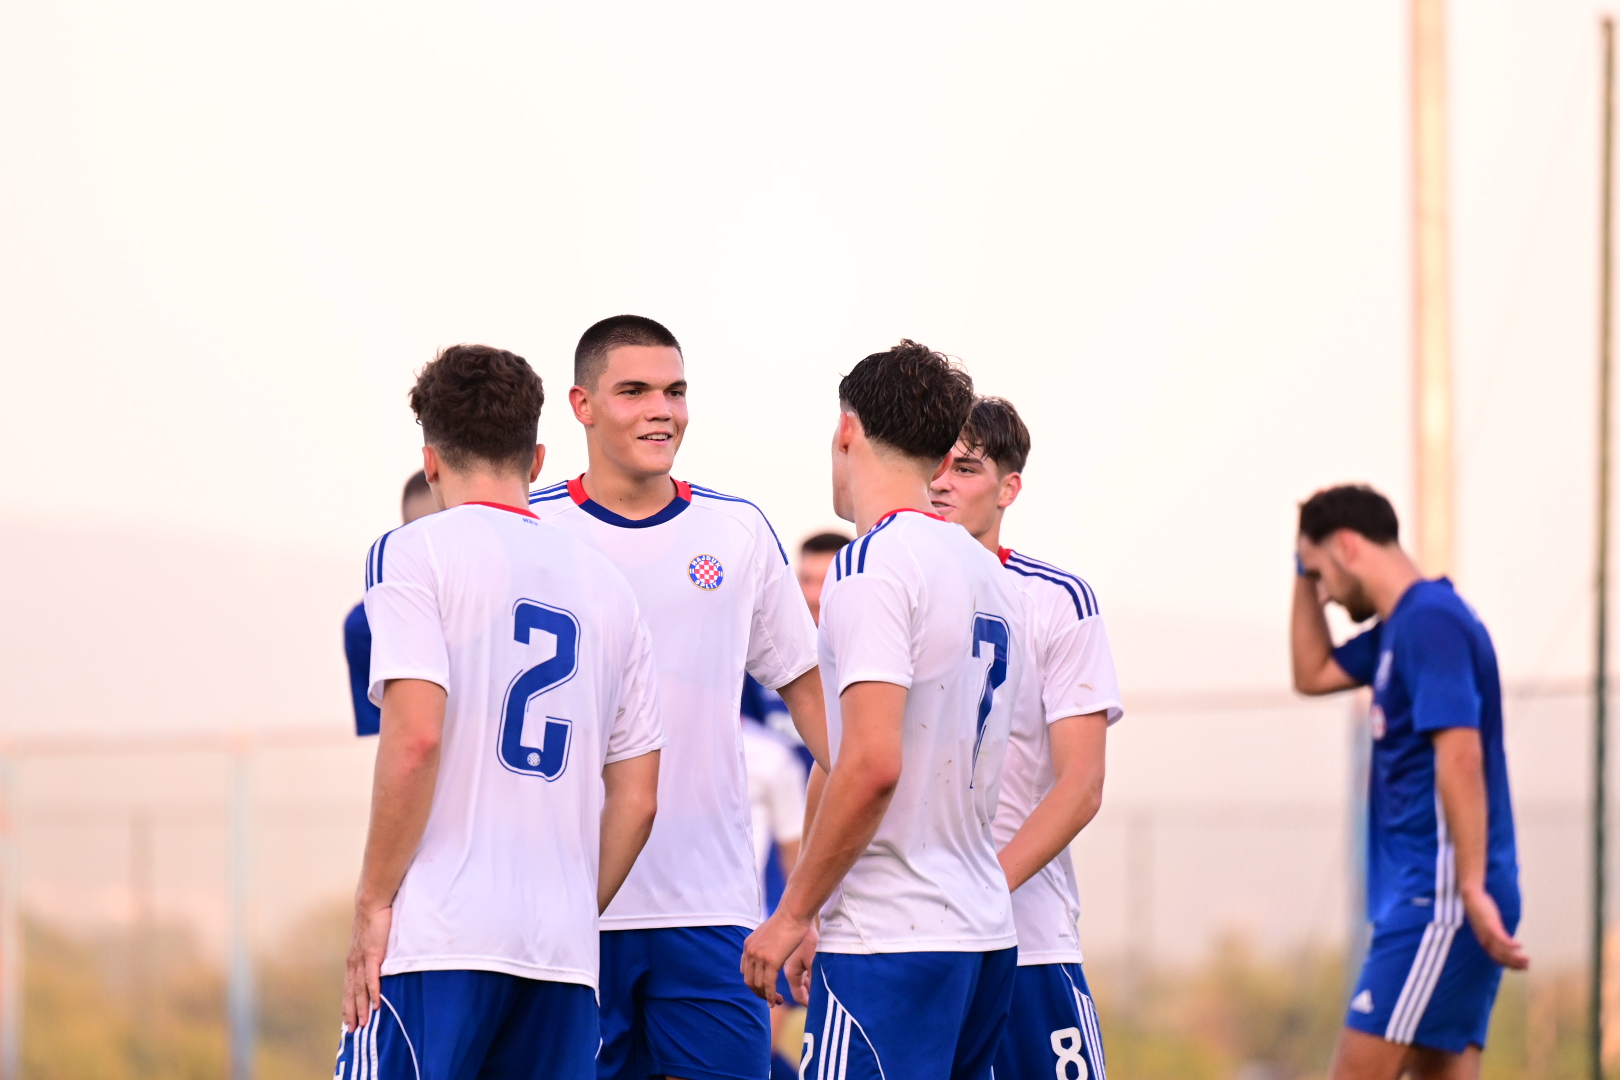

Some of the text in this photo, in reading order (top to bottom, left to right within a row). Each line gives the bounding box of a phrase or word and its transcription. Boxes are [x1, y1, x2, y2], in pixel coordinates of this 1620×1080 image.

[691, 555, 720, 568] HAJDUK
[694, 579, 718, 589] SPLIT
[497, 597, 581, 782] 2
[968, 611, 1011, 789] 7
[1050, 1026, 1088, 1080] 8
